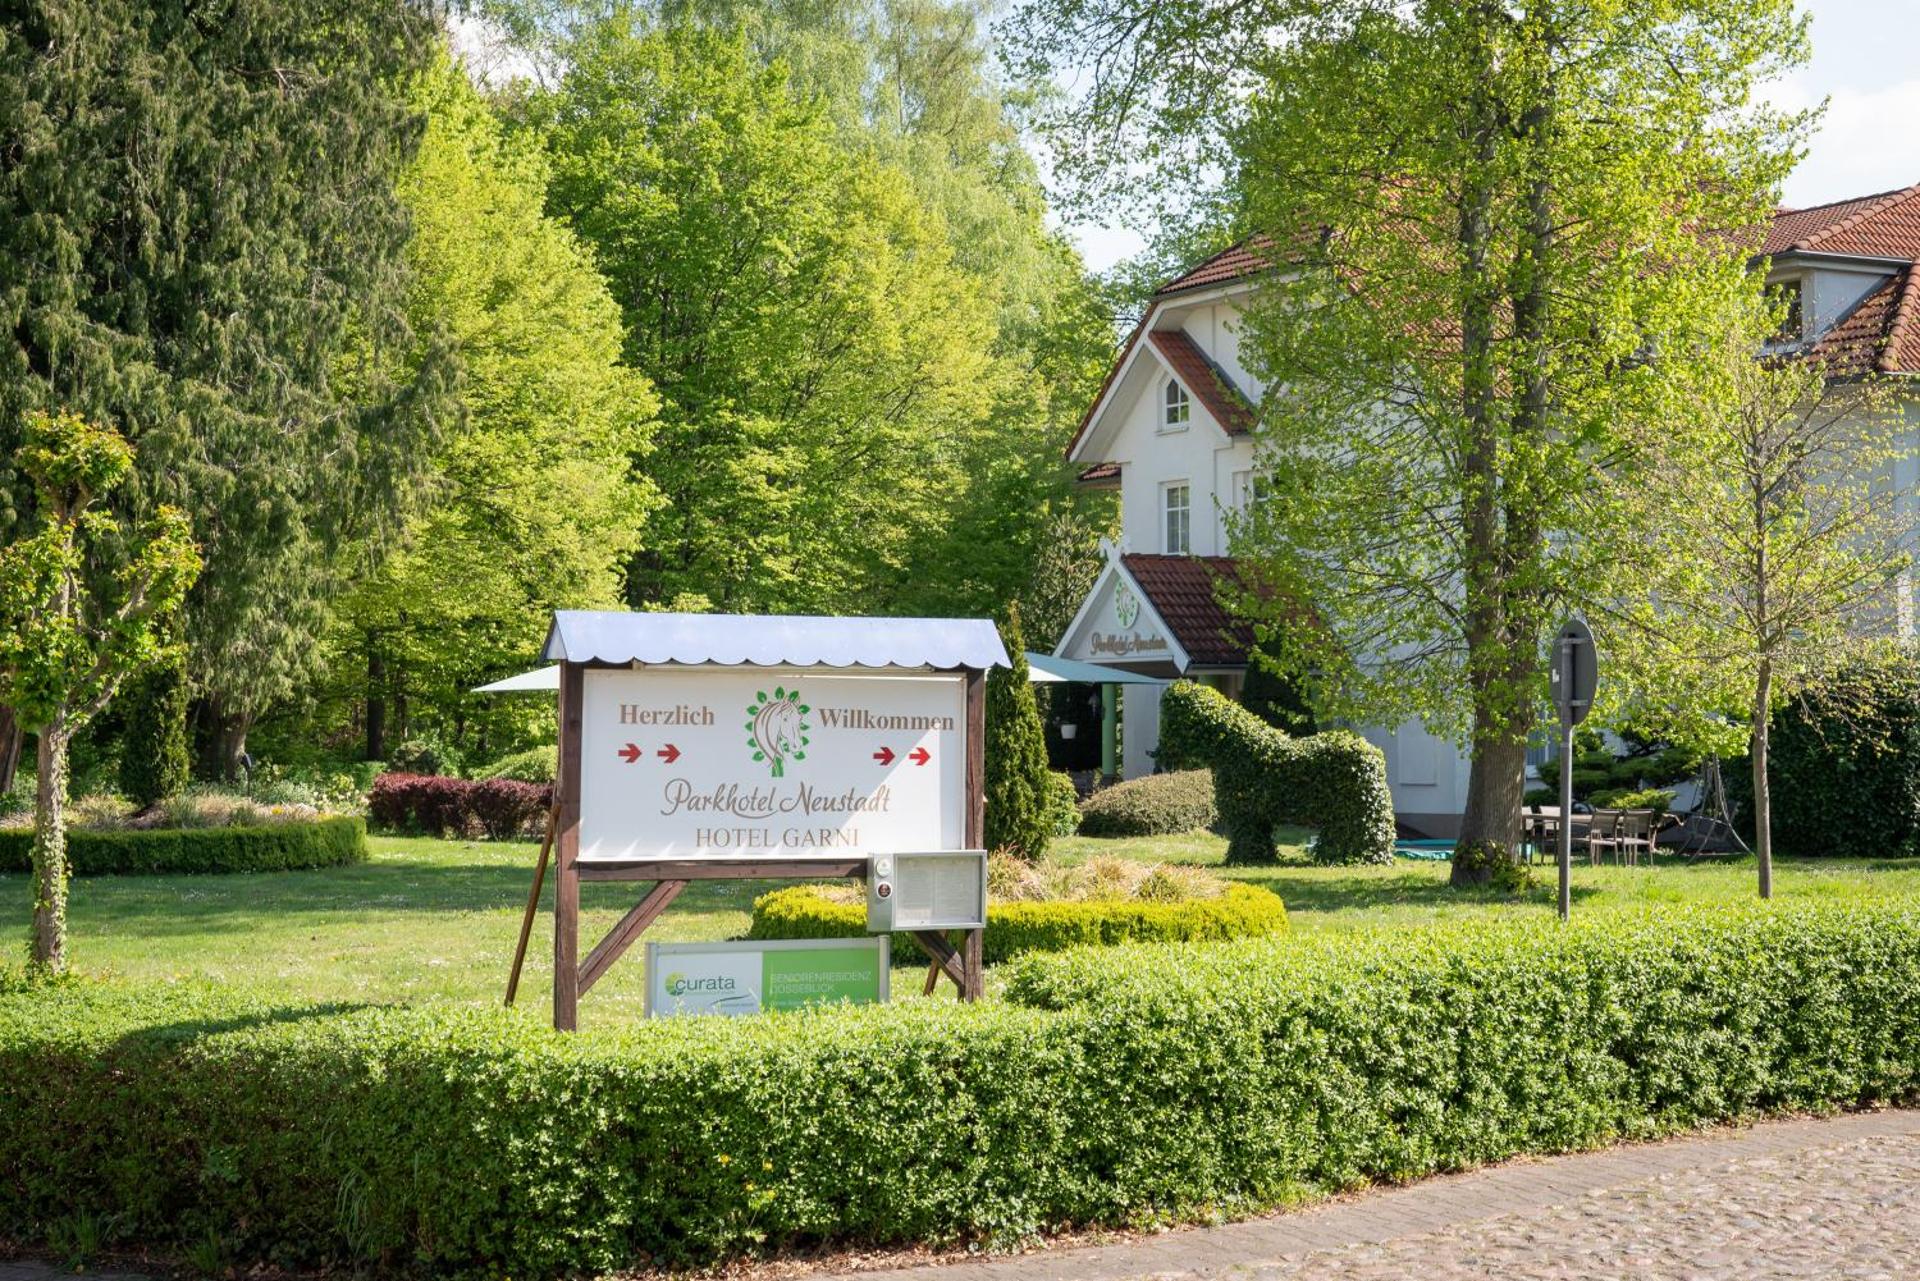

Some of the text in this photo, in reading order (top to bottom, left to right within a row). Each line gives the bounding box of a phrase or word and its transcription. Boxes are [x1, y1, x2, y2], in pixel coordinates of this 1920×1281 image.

[619, 704, 954, 730] Herzlich Willkommen
[660, 778, 891, 819] Parkhotel Neustadt
[696, 827, 859, 848] HOTEL GARNI
[675, 975, 736, 992] curata
